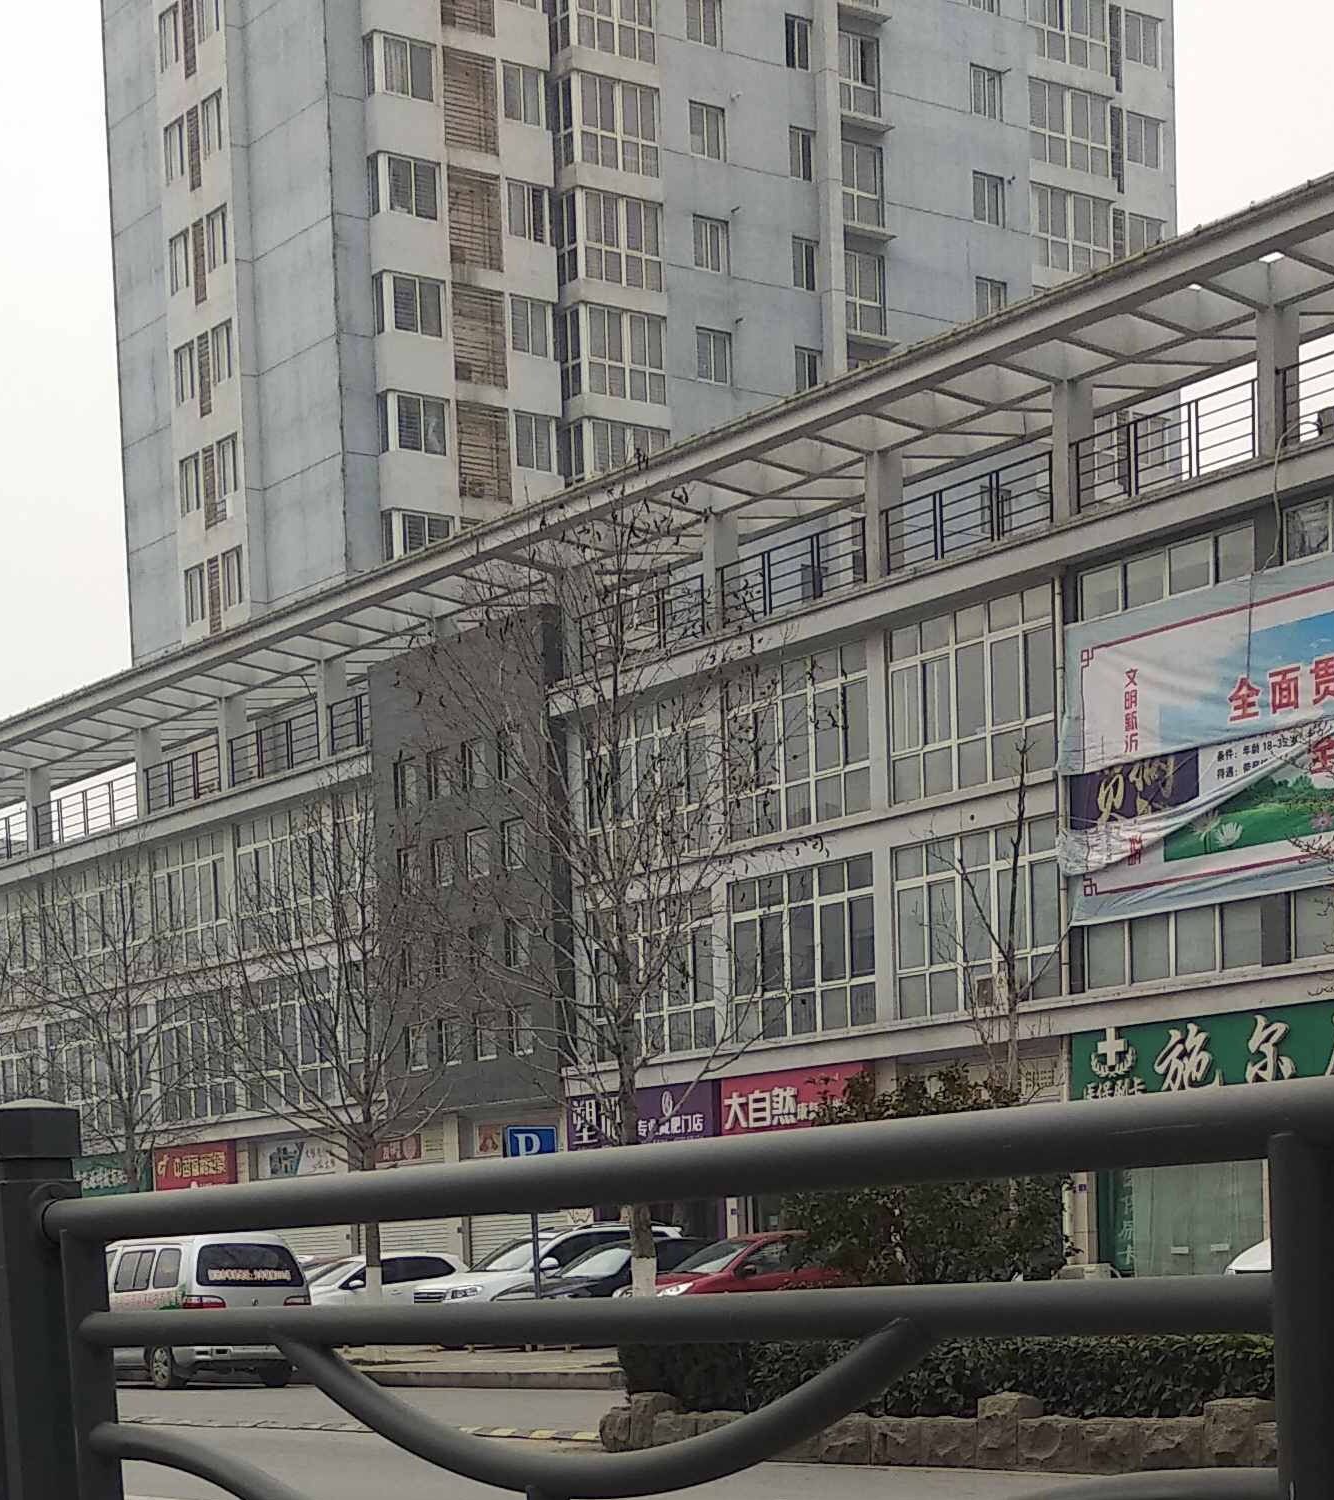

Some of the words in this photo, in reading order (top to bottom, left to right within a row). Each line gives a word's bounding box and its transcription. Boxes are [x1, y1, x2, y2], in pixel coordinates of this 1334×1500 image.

[1123, 667, 1139, 753] 文明新沂
[723, 1086, 798, 1130] 大自然
